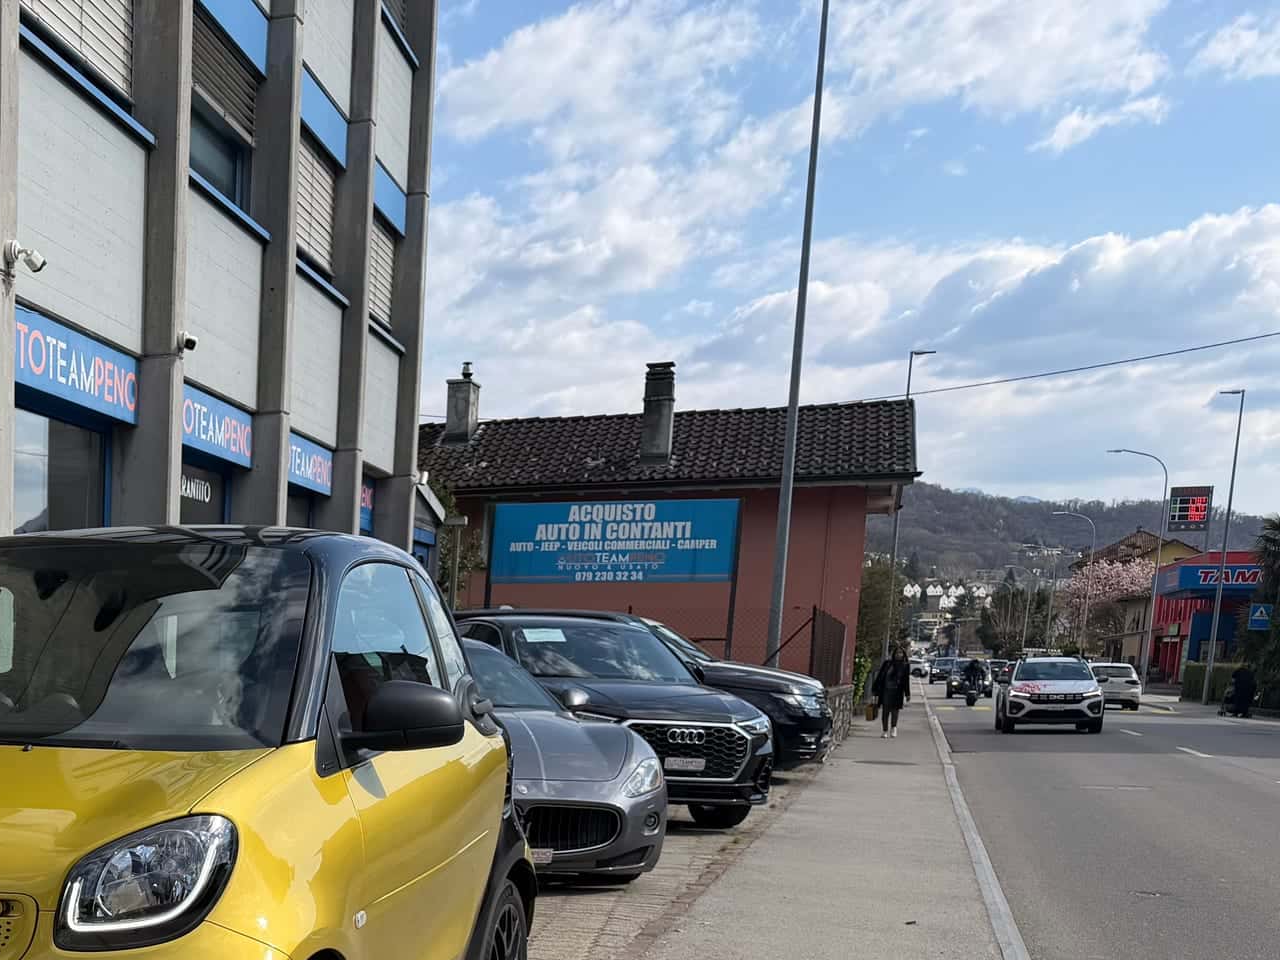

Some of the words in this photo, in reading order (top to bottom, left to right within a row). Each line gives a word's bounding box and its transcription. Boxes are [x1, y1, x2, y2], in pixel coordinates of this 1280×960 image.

[568, 504, 656, 523] ACQUISTO
[535, 523, 580, 541] AUTO
[584, 523, 602, 540] IN
[606, 521, 691, 540] CONTANTI
[510, 542, 534, 552] AUTO
[540, 541, 561, 551] JEEP
[567, 540, 603, 551] VEICOLI
[604, 540, 670, 550] COMMERCIALI
[677, 539, 717, 549] CAMPER
[575, 571, 593, 581] 079
[595, 571, 613, 581] 230
[615, 571, 629, 581] 32
[630, 571, 643, 580] 34
[1199, 569, 1264, 584] TAM
